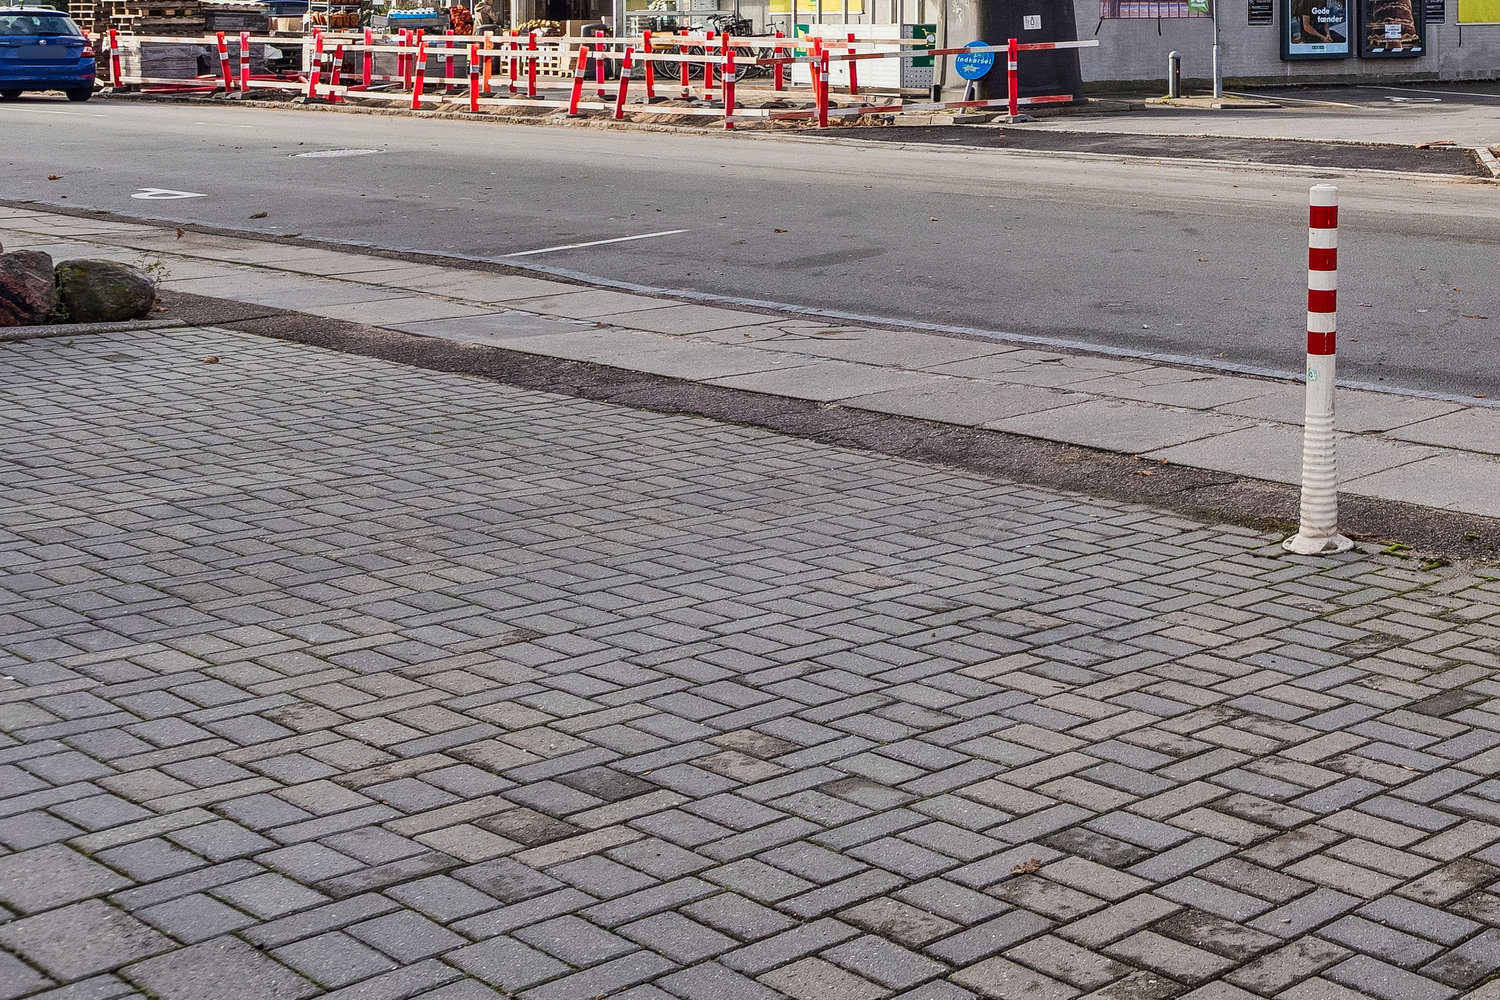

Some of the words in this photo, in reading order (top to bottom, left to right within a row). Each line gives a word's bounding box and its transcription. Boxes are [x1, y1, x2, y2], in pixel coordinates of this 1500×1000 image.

[1311, 7, 1330, 15] Gode
[1317, 15, 1344, 23] tænder
[957, 56, 992, 65] Indkørsel
